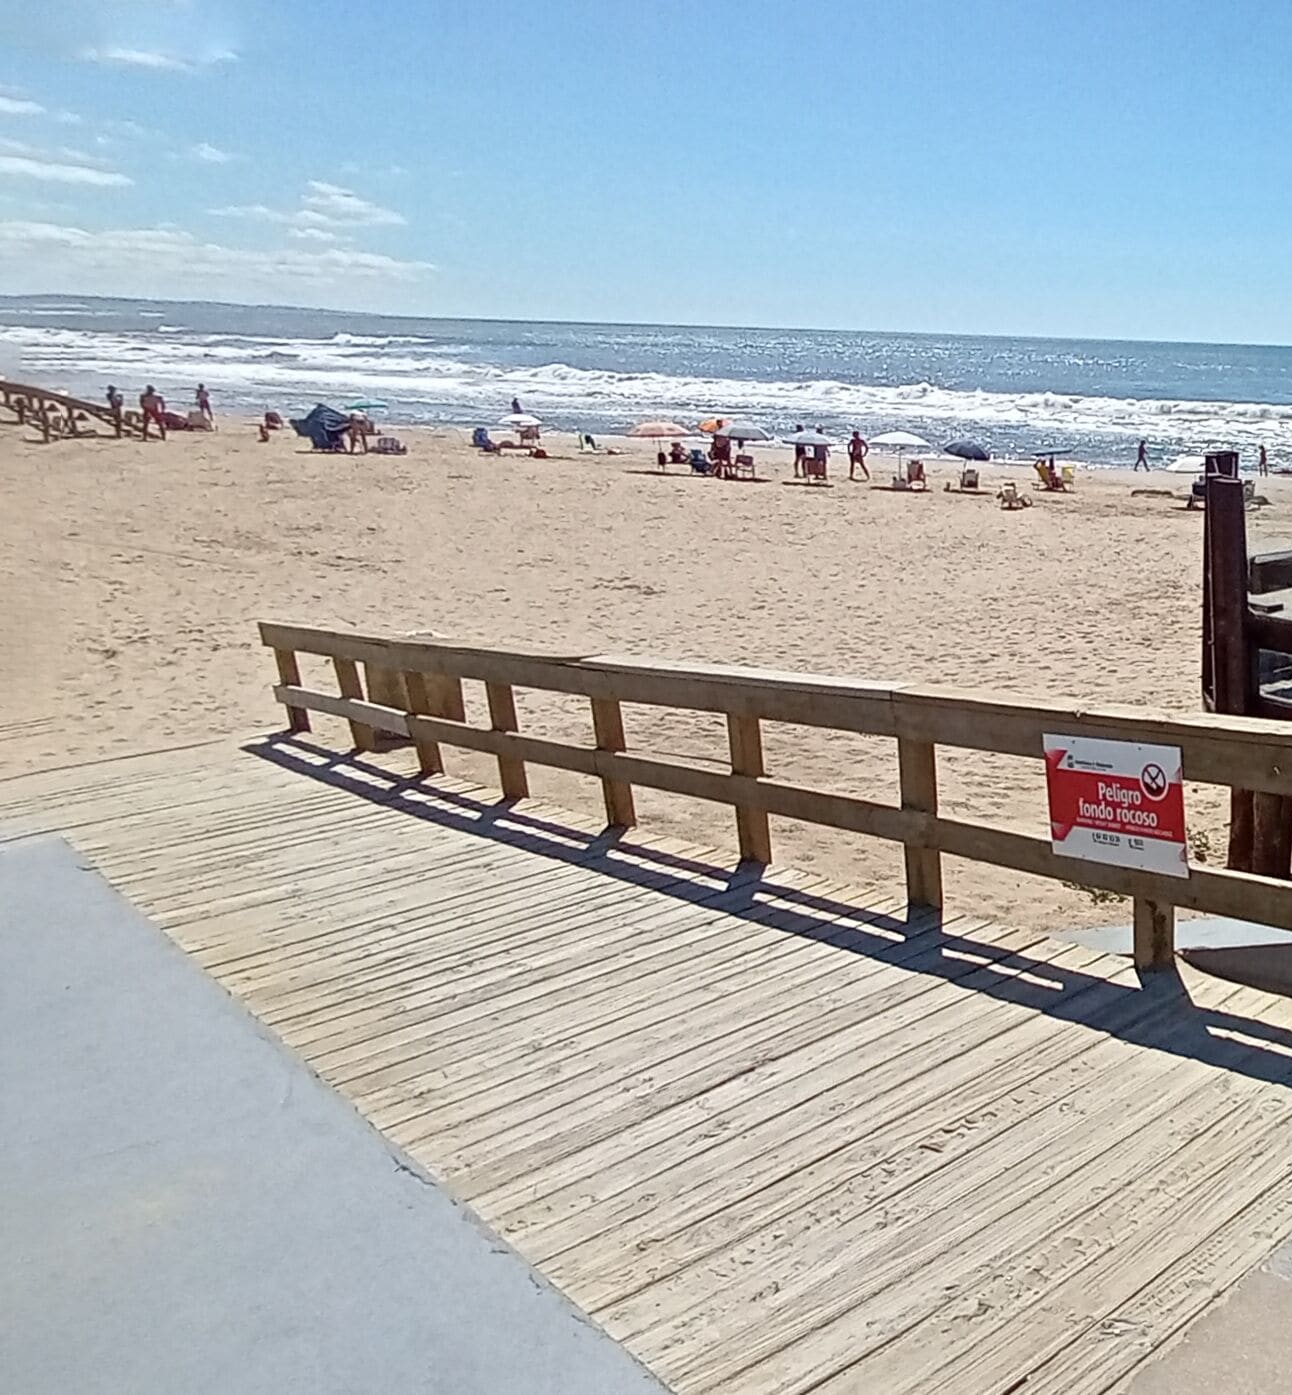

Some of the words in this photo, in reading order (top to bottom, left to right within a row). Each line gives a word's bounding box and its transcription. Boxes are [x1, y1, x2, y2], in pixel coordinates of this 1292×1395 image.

[1097, 782, 1142, 806] Peligro
[1078, 798, 1113, 820] fondo
[1116, 808, 1158, 828] rocoso
